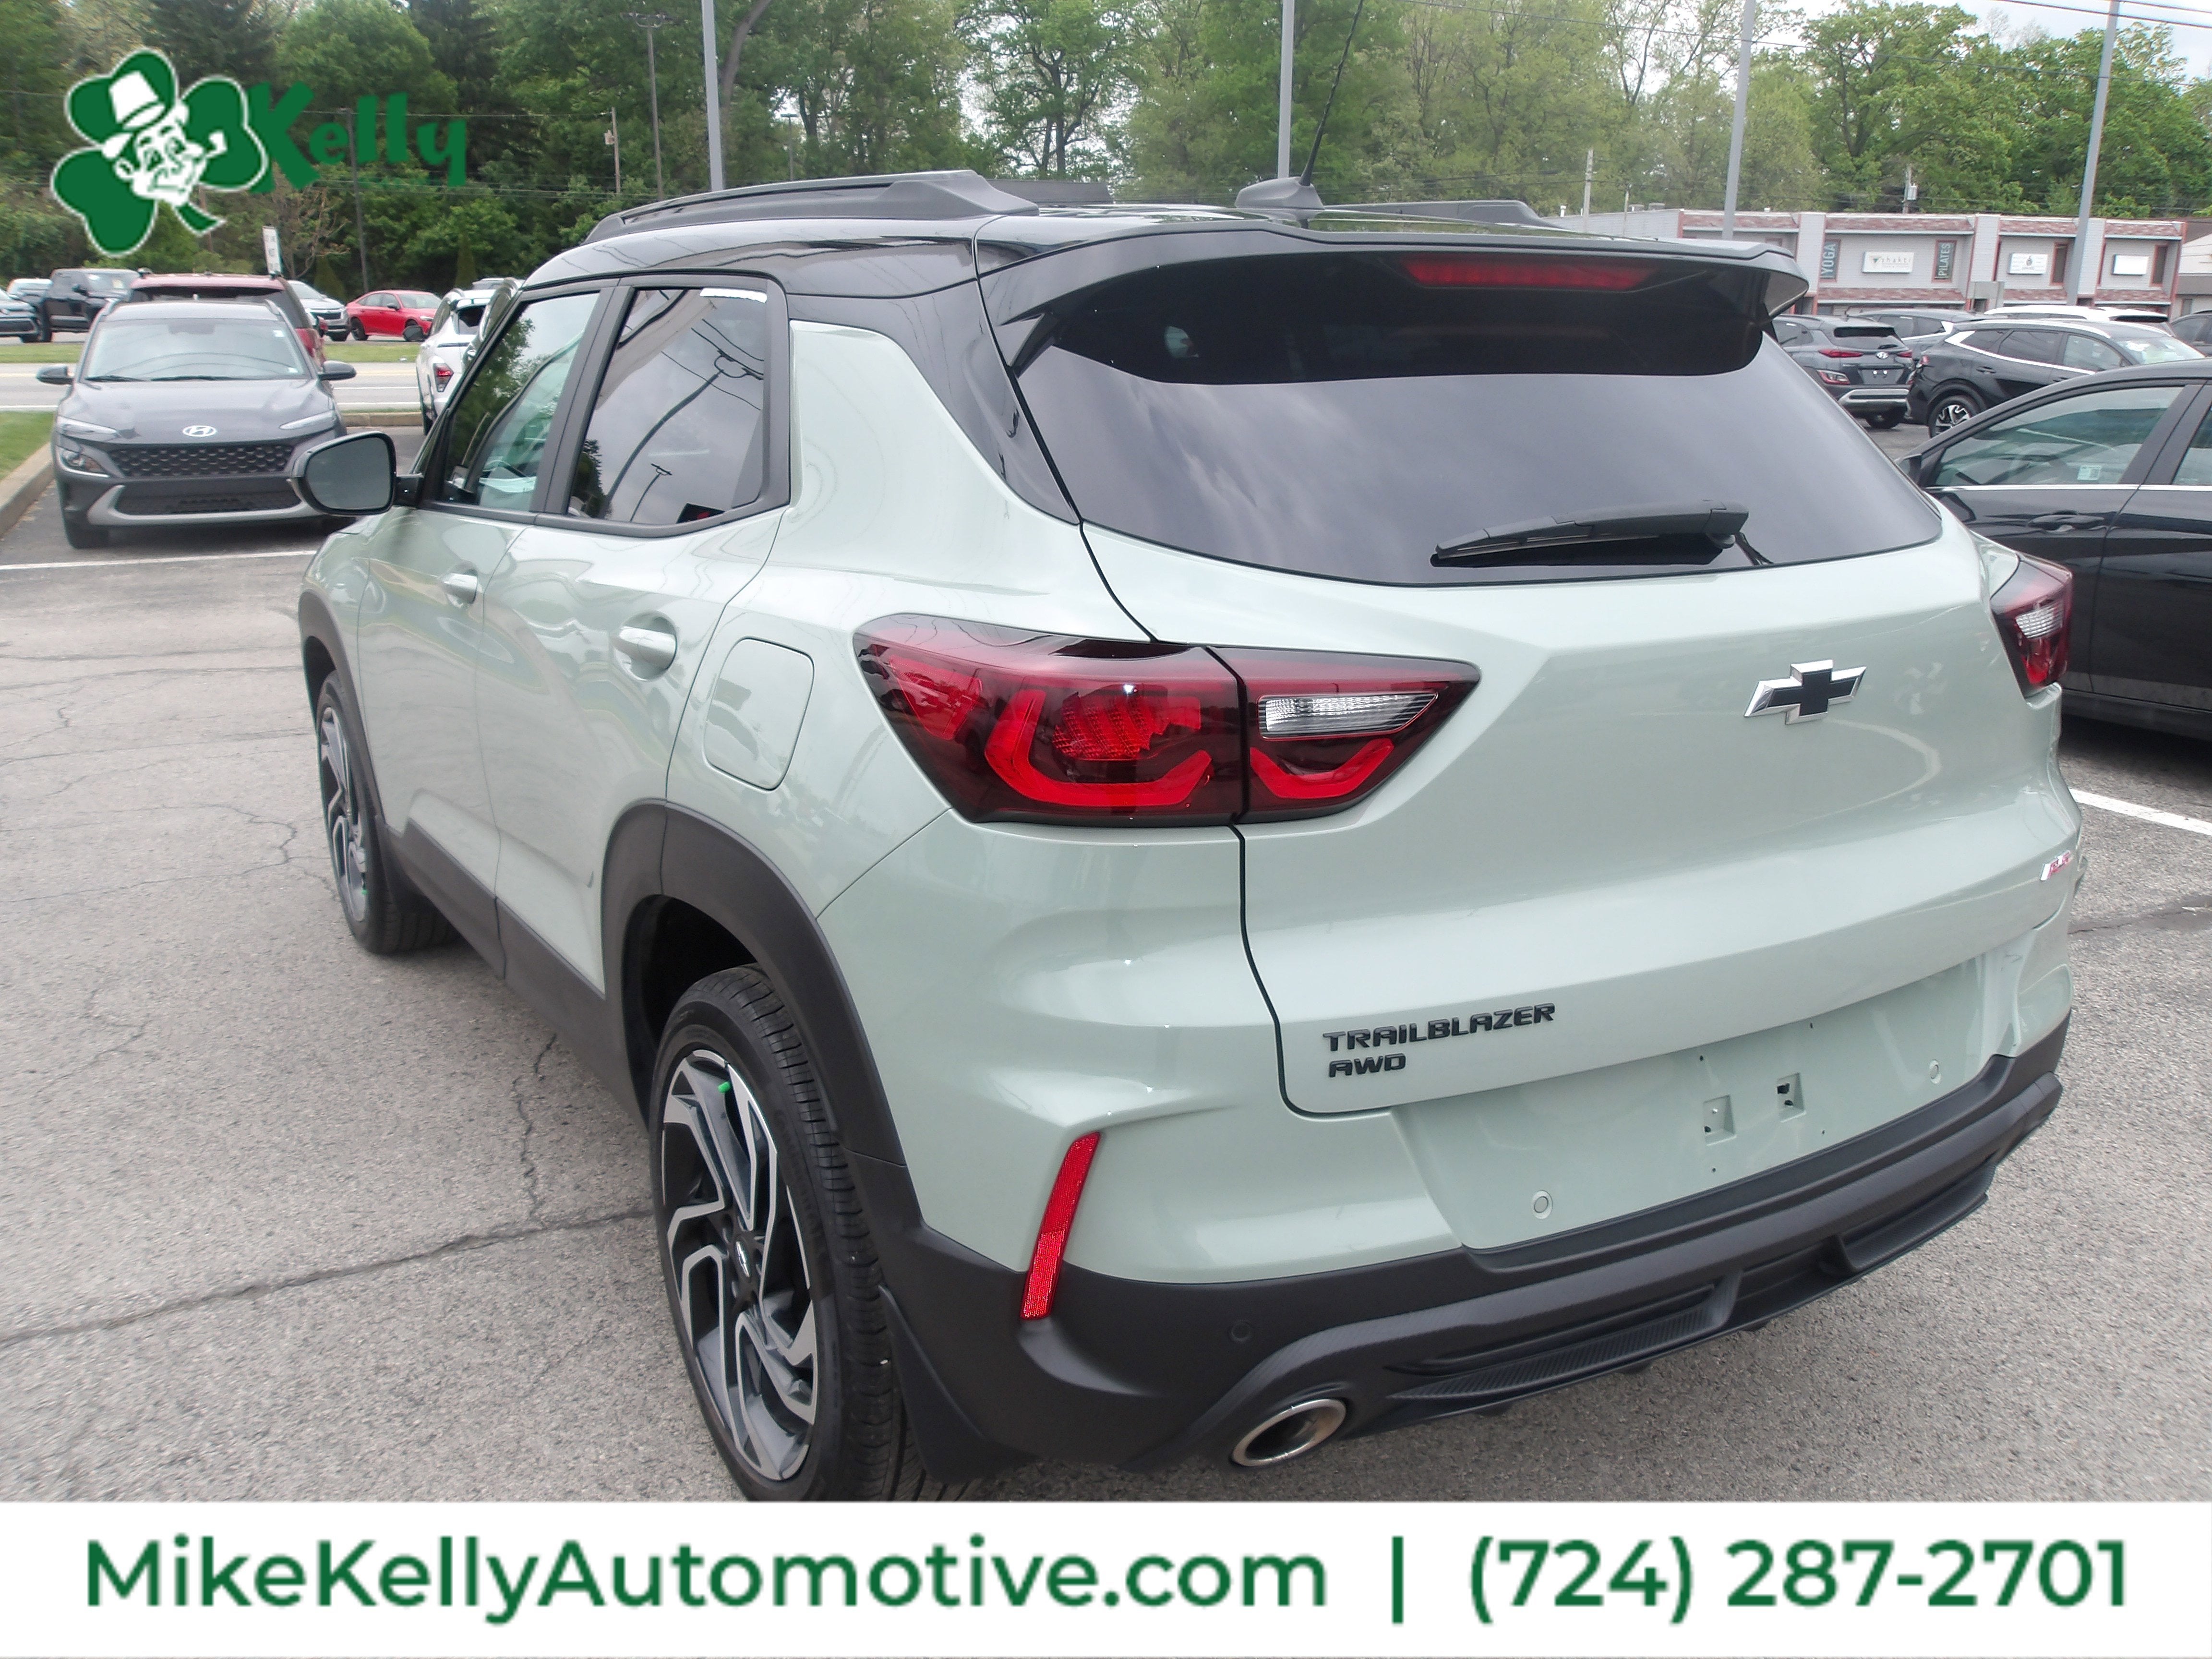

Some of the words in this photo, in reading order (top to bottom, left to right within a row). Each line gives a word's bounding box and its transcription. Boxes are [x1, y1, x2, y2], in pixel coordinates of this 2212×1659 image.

[1821, 244, 1836, 274] YOGA
[1938, 242, 1950, 276] PILATES
[1323, 1002, 1555, 1052] TRAILBLAZER
[1328, 1053, 1406, 1078] AWD
